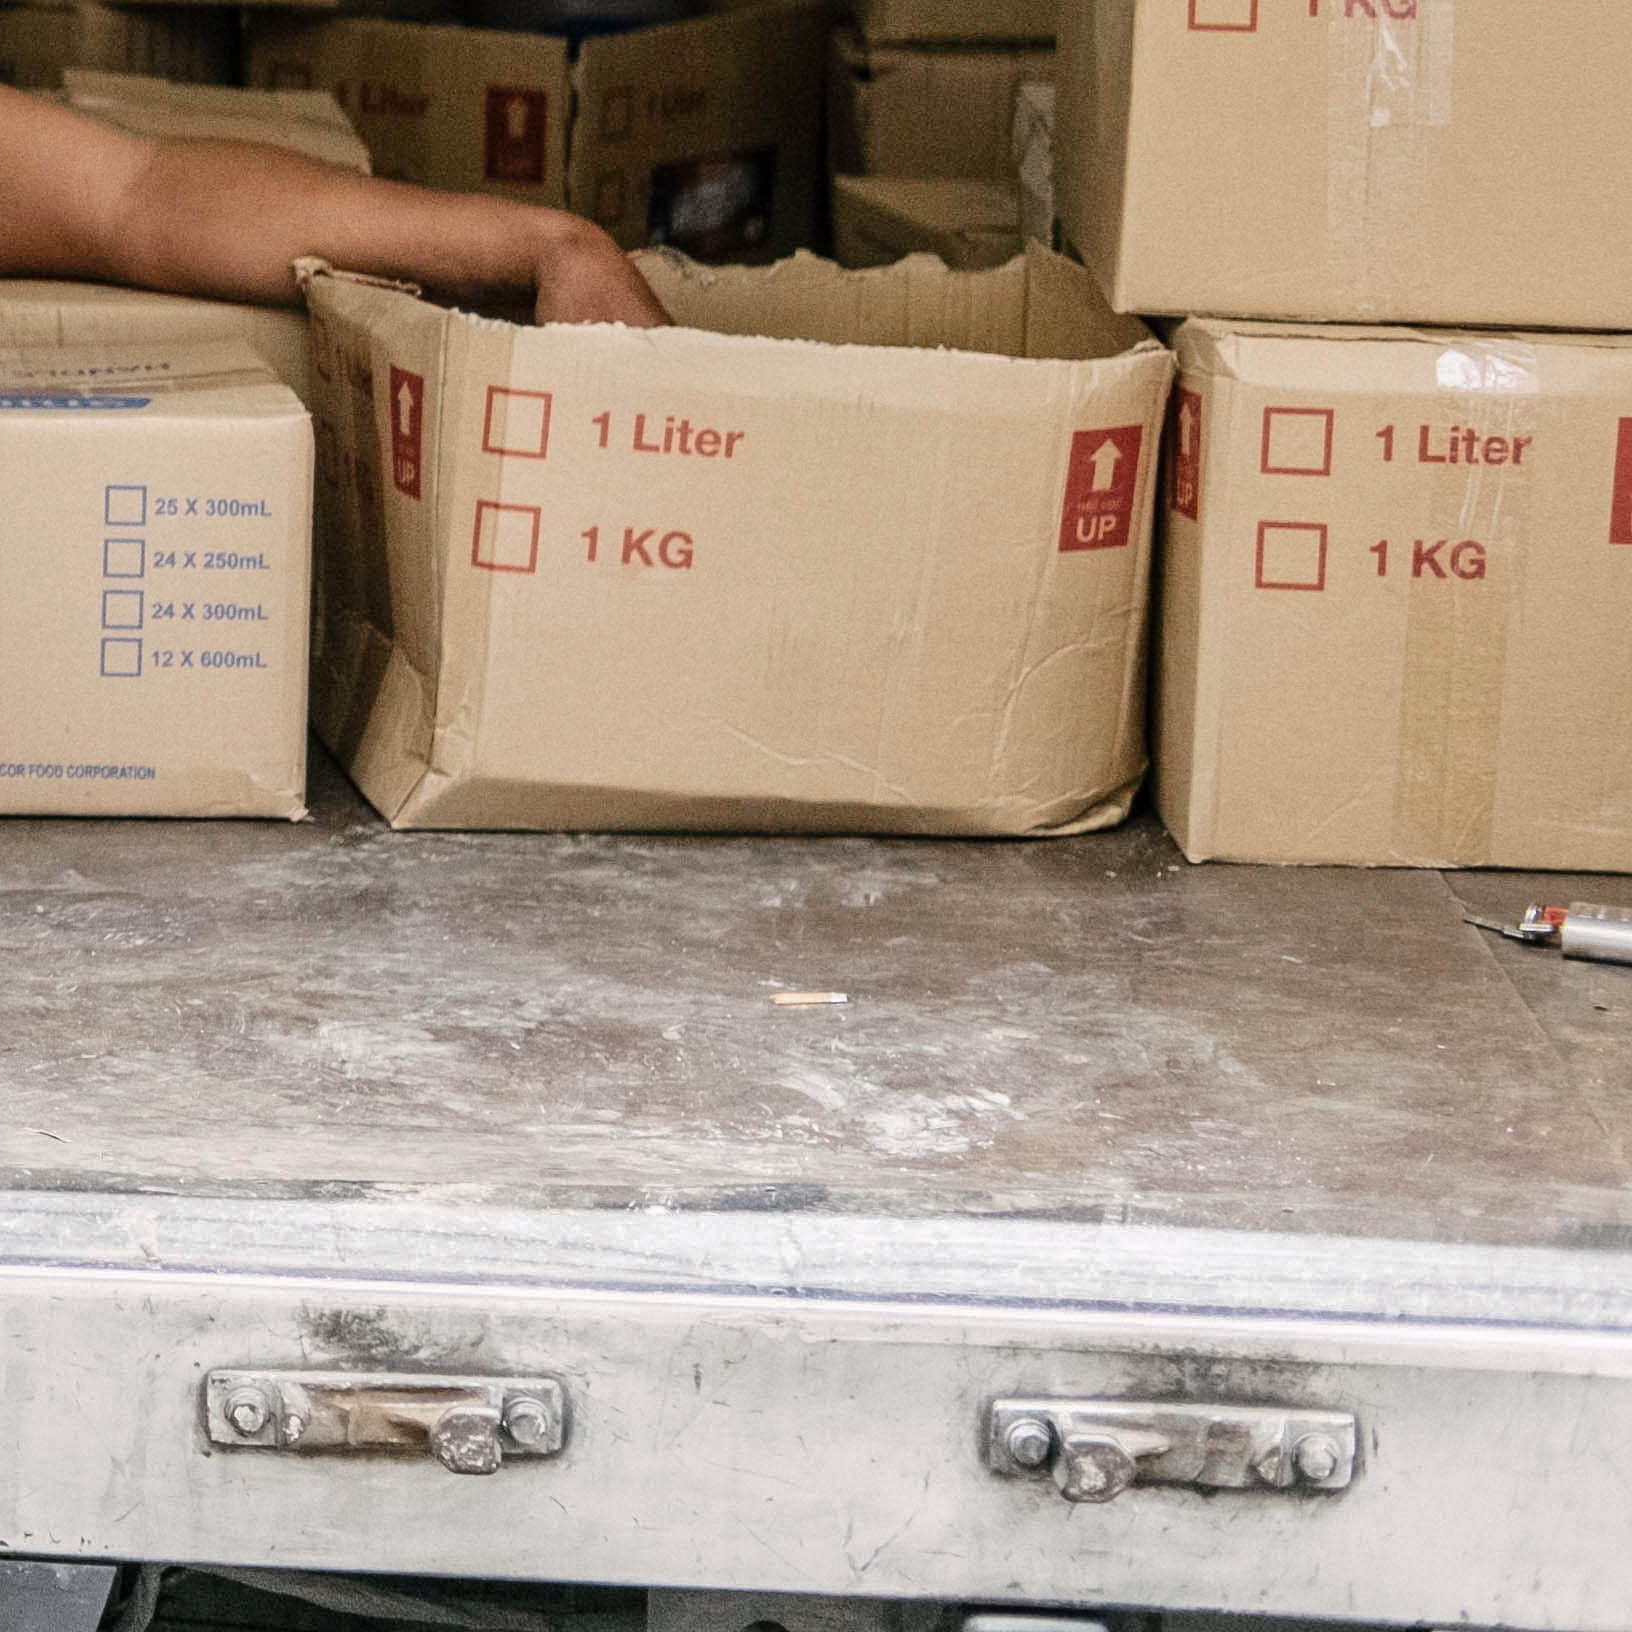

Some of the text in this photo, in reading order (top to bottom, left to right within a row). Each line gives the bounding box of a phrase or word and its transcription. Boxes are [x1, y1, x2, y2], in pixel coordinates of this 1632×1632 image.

[592, 411, 745, 459] 1 Liter
[1375, 424, 1533, 466] 1 Liter
[155, 497, 273, 518] 25 X 300mL
[1076, 514, 1117, 543] UP
[581, 525, 694, 570] 1 KG
[1369, 539, 1487, 581] 1 KG
[153, 551, 271, 570] 24 X 250mL
[151, 601, 269, 621] 24 X 300mL
[151, 650, 268, 669] 12 X 600mL
[28, 763, 64, 779] FOOD
[66, 763, 157, 781] CORPORATION
